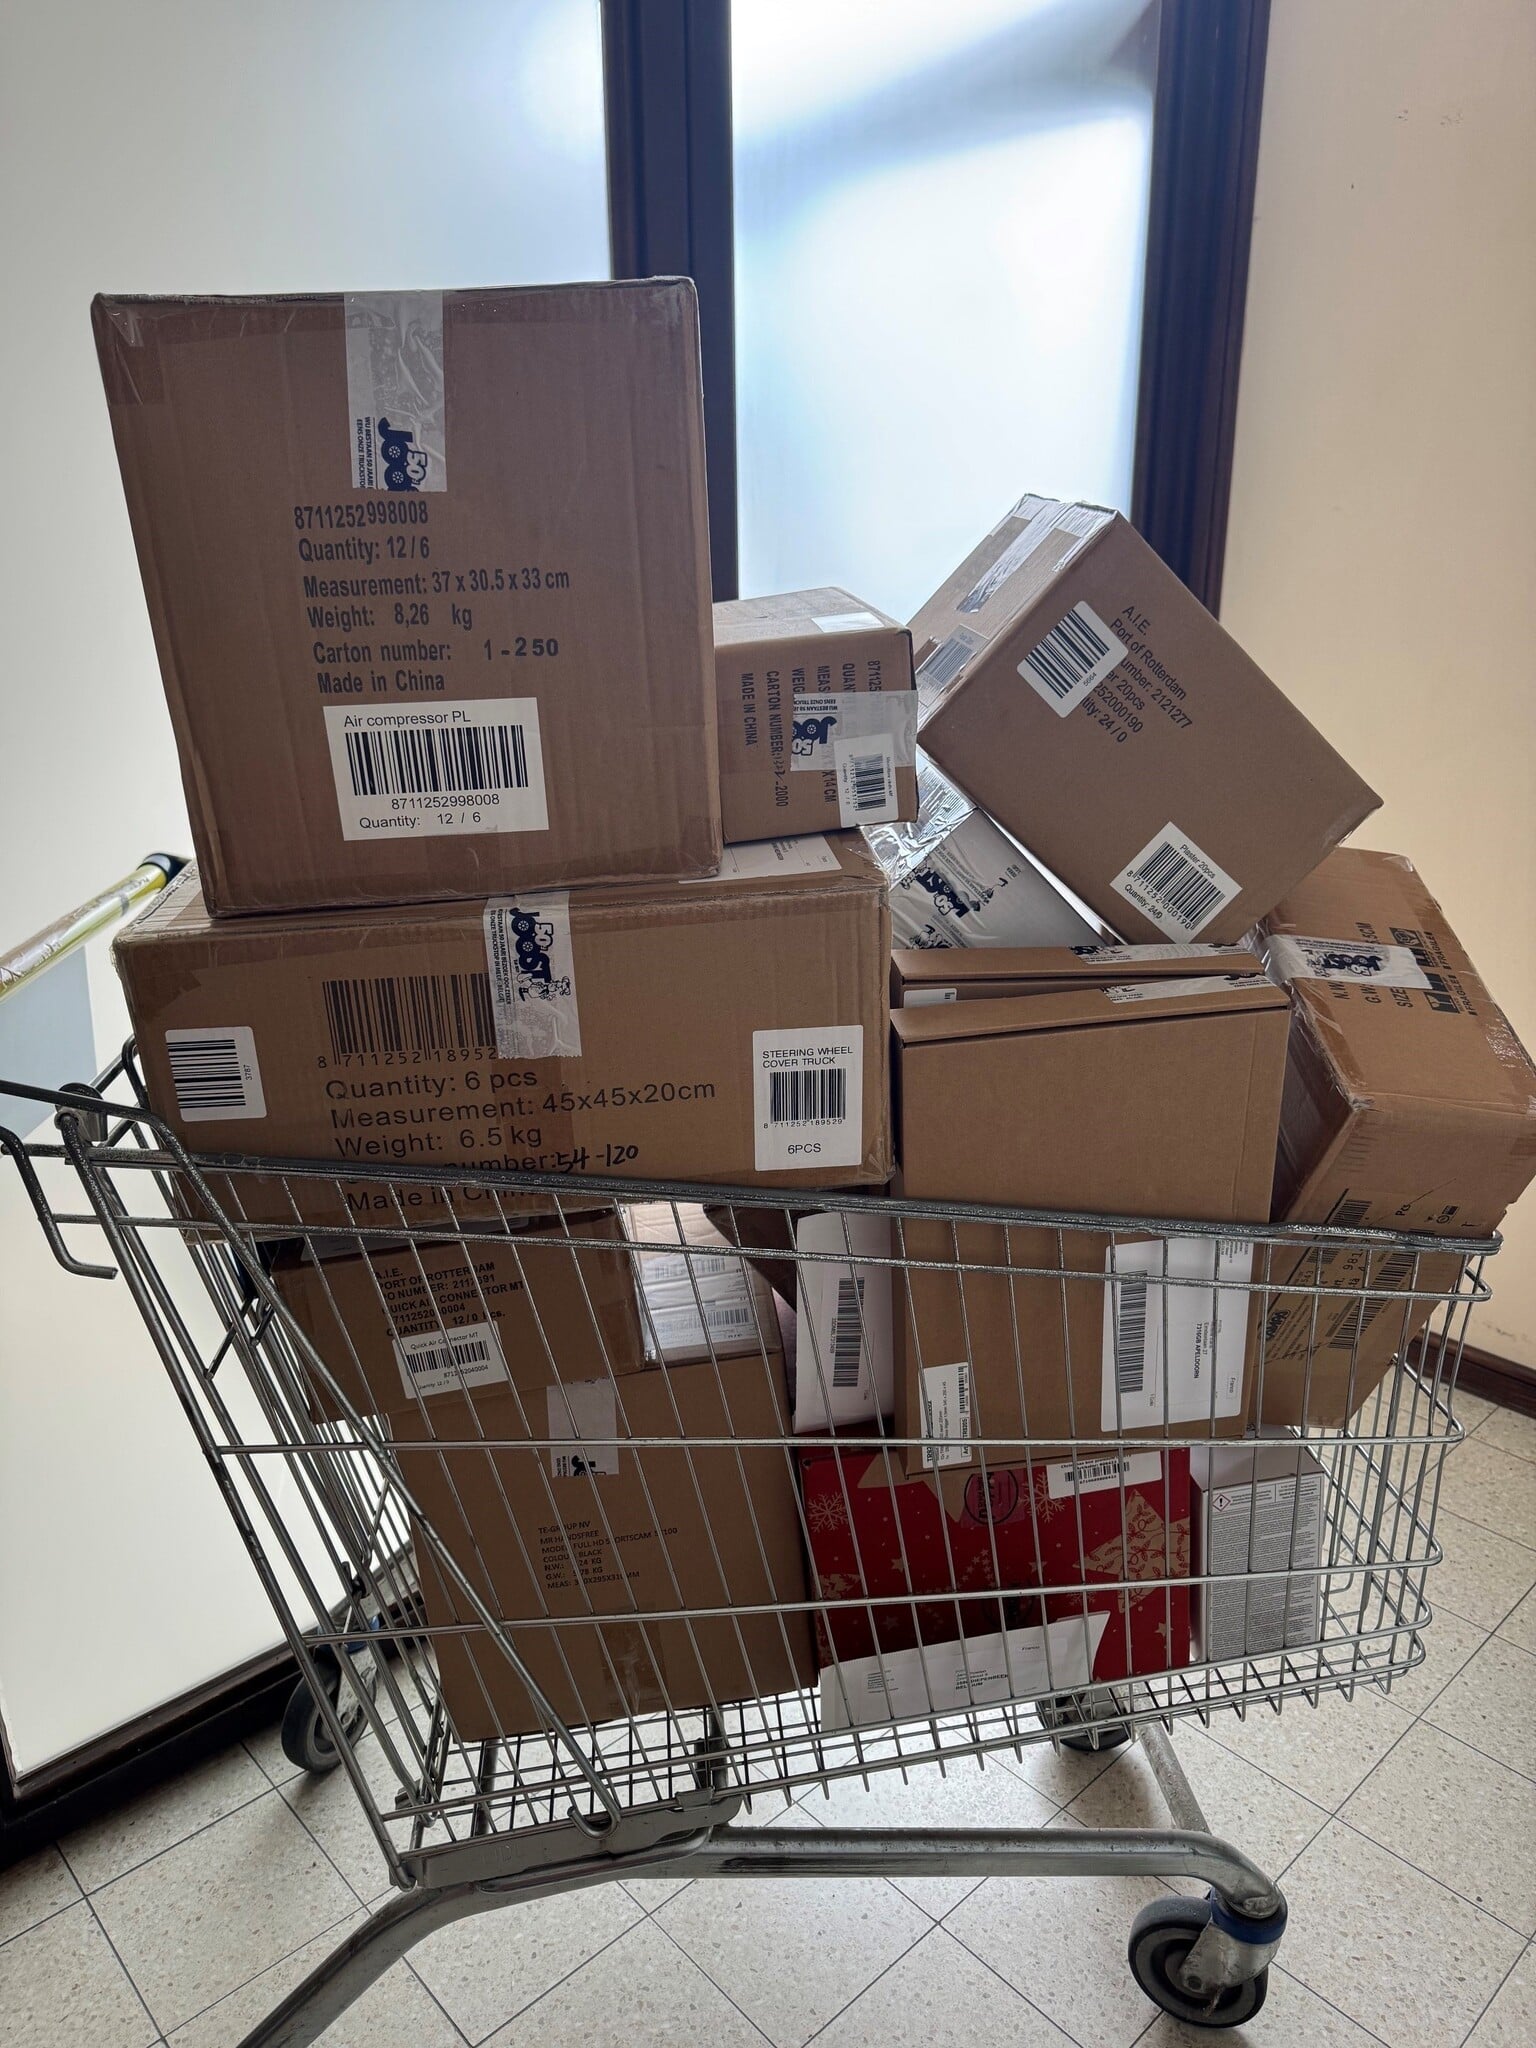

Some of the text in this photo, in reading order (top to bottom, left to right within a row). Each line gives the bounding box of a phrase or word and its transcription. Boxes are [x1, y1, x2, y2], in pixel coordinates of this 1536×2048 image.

[294, 501, 428, 529] 8711252998008
[298, 536, 380, 565] Quantity:
[304, 574, 427, 597] Measurement:
[469, 569, 505, 591] 30.5
[522, 567, 541, 589] 33
[545, 570, 569, 588] cm
[308, 603, 472, 632] Weight: 8,26 kg
[313, 642, 371, 664] Carton
[381, 640, 451, 662] number:
[317, 669, 445, 693] Made in China
[792, 667, 805, 693] WEIG
[817, 665, 831, 693] MEAS
[1141, 651, 1187, 700] Rotterdam
[1093, 683, 1144, 733] 252000190
[1116, 680, 1146, 711] 20pcs
[1120, 660, 1193, 729] umber: 2121277
[344, 711, 471, 729] Air compressor PL
[741, 673, 758, 746] MADE IN CHINA
[766, 671, 784, 755] CARTON NUMBER:
[391, 793, 500, 810] 8711252998008
[359, 815, 420, 830] Quantity:
[437, 813, 453, 825] 12
[472, 812, 481, 823] 6
[1180, 844, 1200, 863] Plaster
[1124, 884, 1149, 909] Quantity:
[509, 908, 551, 983] JOOST
[534, 922, 554, 947] 50
[762, 1046, 853, 1059] STEERING WHEEL
[763, 1056, 836, 1069] COVER TRUCK
[326, 1071, 537, 1100] Quantity: 6 pcs
[331, 1082, 715, 1129] Measurement: 45x45x20cm
[335, 1125, 541, 1158] Weight: 6.5 kg
[787, 1143, 821, 1154] 6PCS
[382, 1301, 416, 1315] UICK
[440, 1283, 508, 1304] CONNETOR
[410, 1340, 428, 1350] Quick
[438, 1334, 469, 1345] Conector
[606, 1532, 651, 1545] SORTSCAM
[543, 1554, 570, 1563] COLOU
